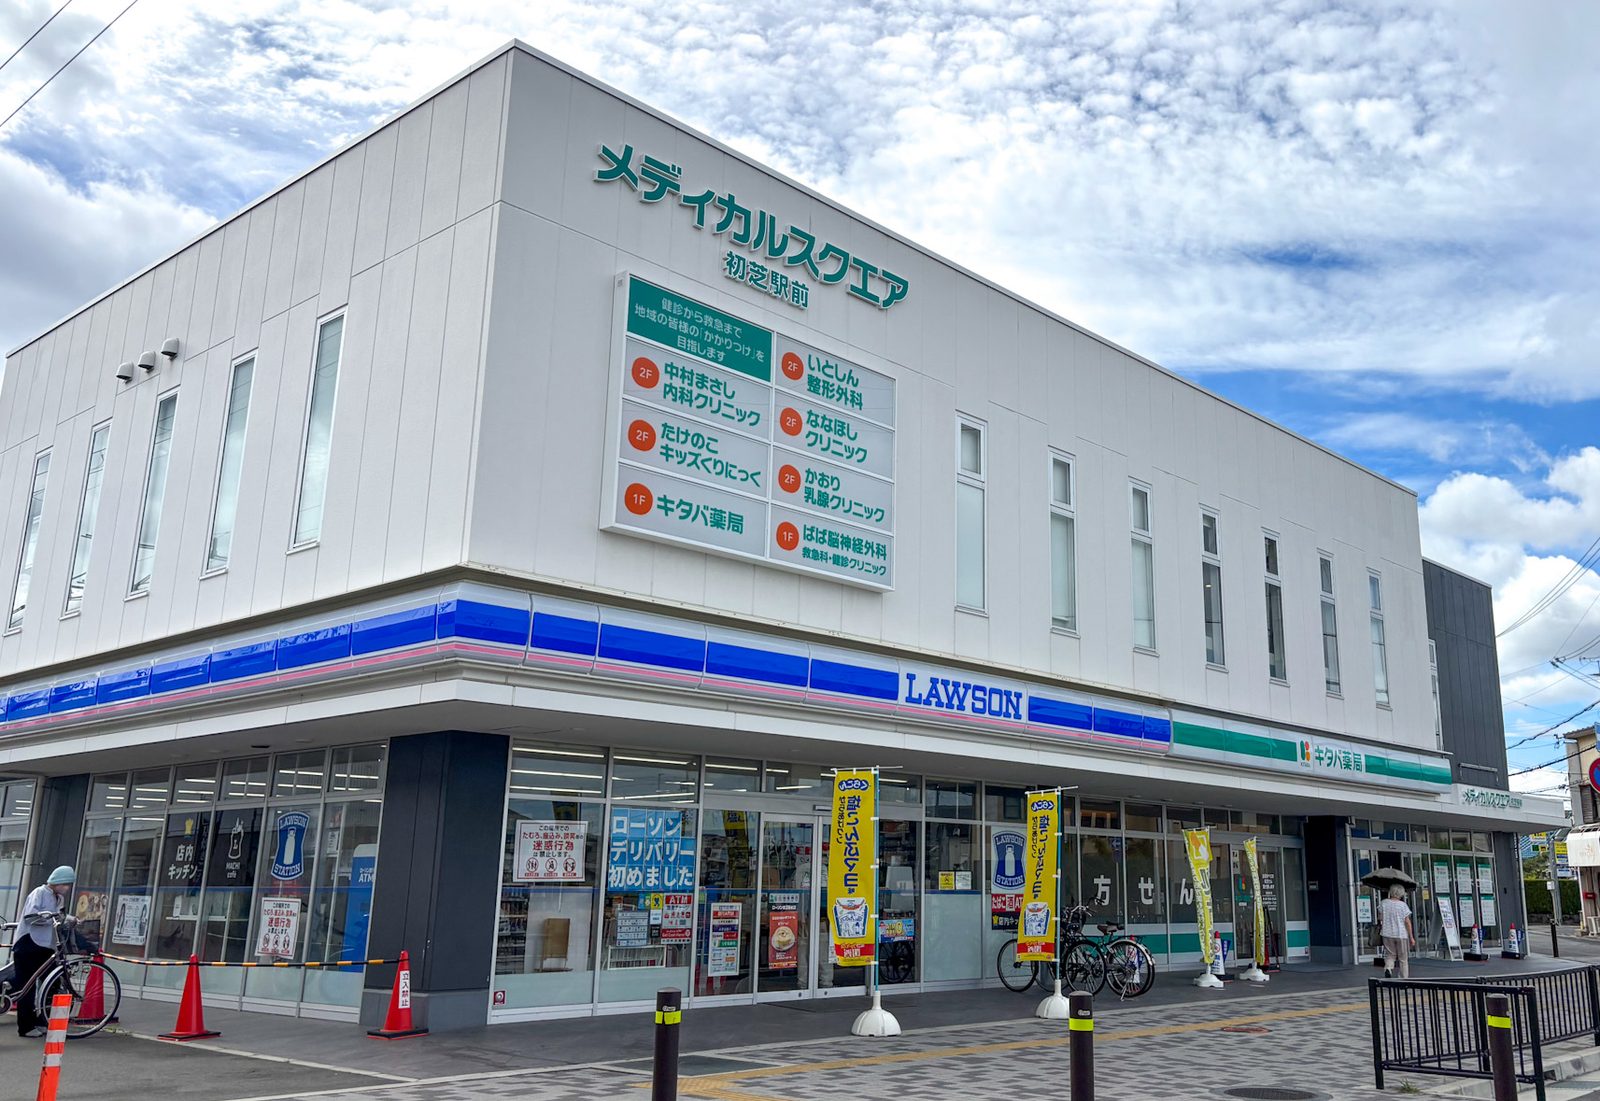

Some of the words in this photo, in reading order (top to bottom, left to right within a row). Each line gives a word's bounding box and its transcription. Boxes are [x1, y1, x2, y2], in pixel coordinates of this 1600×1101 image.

[594, 144, 909, 309] メディカルスクエア
[723, 250, 810, 309] 初芝駅前
[661, 297, 743, 339] 健診から救急まで
[634, 303, 765, 363] 地域の皆様の「かかりつけ」を
[677, 335, 727, 362] 目指します
[639, 367, 653, 380] 2F
[788, 360, 799, 371] 2F
[807, 353, 860, 387] いとしん
[664, 361, 736, 400] 中村まさし
[807, 374, 864, 411] 整形外科
[662, 383, 761, 427] 内科クリニック
[786, 416, 797, 428] 2F
[806, 409, 858, 439] ななほし
[635, 428, 649, 442] 2F
[660, 422, 719, 455] たけのこ
[805, 430, 868, 464] クリニック
[659, 444, 762, 488] キッズくりにっく
[784, 473, 796, 485] 2F
[804, 468, 841, 491] かおり
[632, 493, 646, 506] 1F
[803, 485, 886, 523] 乳腺クリニック
[656, 494, 745, 535] キタバ薬局
[783, 531, 794, 542] 1F
[802, 524, 888, 560] ばば脳神経外科
[905, 673, 1022, 720] LAWSON
[1314, 745, 1363, 772] キタバ薬局
[280, 815, 307, 829] LAWSON
[613, 816, 681, 836] ローソン
[532, 840, 575, 851] 迷惑行為
[611, 840, 695, 862] デリバリー
[995, 834, 1025, 847] LAWSON
[176, 844, 194, 861] 店内
[168, 863, 198, 880] キッチン
[225, 862, 240, 870] MACHI
[273, 863, 301, 877] STATION
[608, 865, 693, 887] 初めました
[995, 874, 1025, 887] STATION
[668, 895, 689, 904] ATM
[401, 972, 409, 1007] 立入禁止
